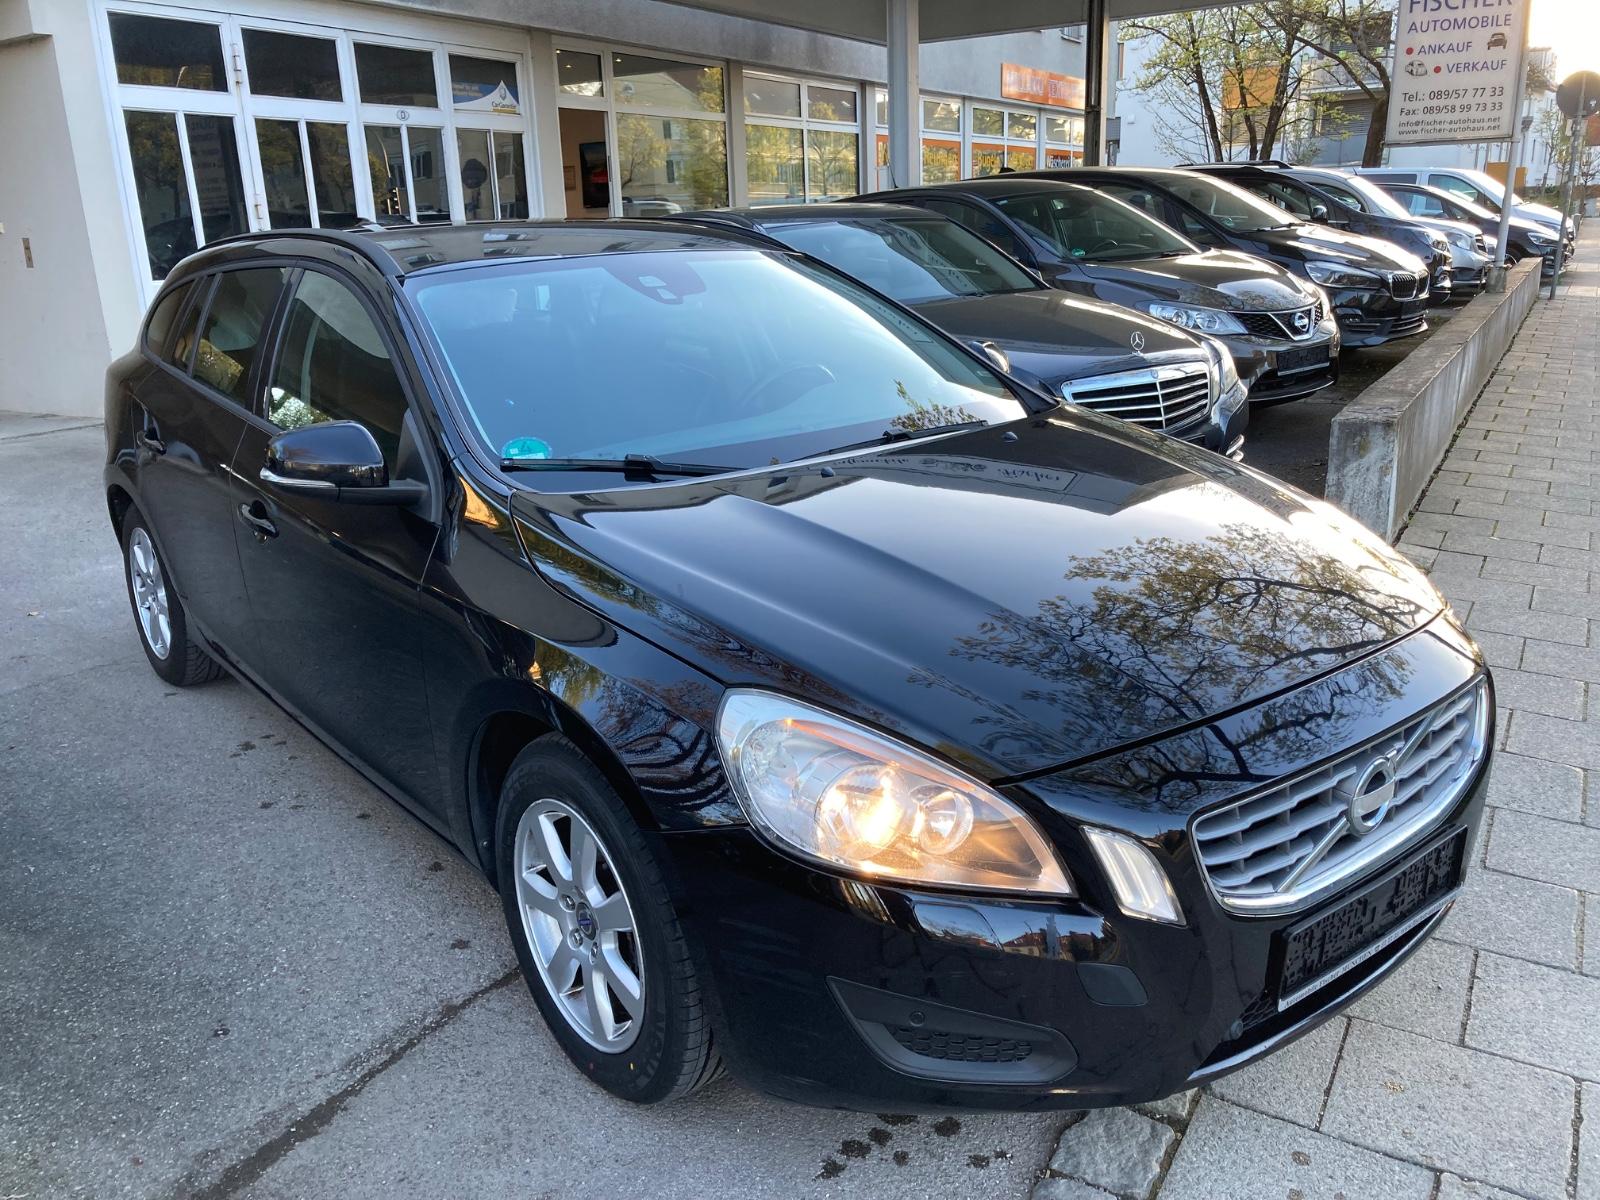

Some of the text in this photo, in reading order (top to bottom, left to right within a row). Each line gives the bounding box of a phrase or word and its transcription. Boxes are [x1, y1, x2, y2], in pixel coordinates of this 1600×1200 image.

[1407, 13, 1513, 34] AUTOMOBILE
[1417, 41, 1473, 56] ANKAUF
[1446, 59, 1508, 74] VERKAUF
[1402, 86, 1505, 102] Tel.: 089/57 77 33
[1400, 101, 1503, 117] Fax: 089/58 99 73 33
[1398, 116, 1501, 128] info@fischer-autohaus.net
[1398, 124, 1501, 136] www.fischer-autohaus.net
